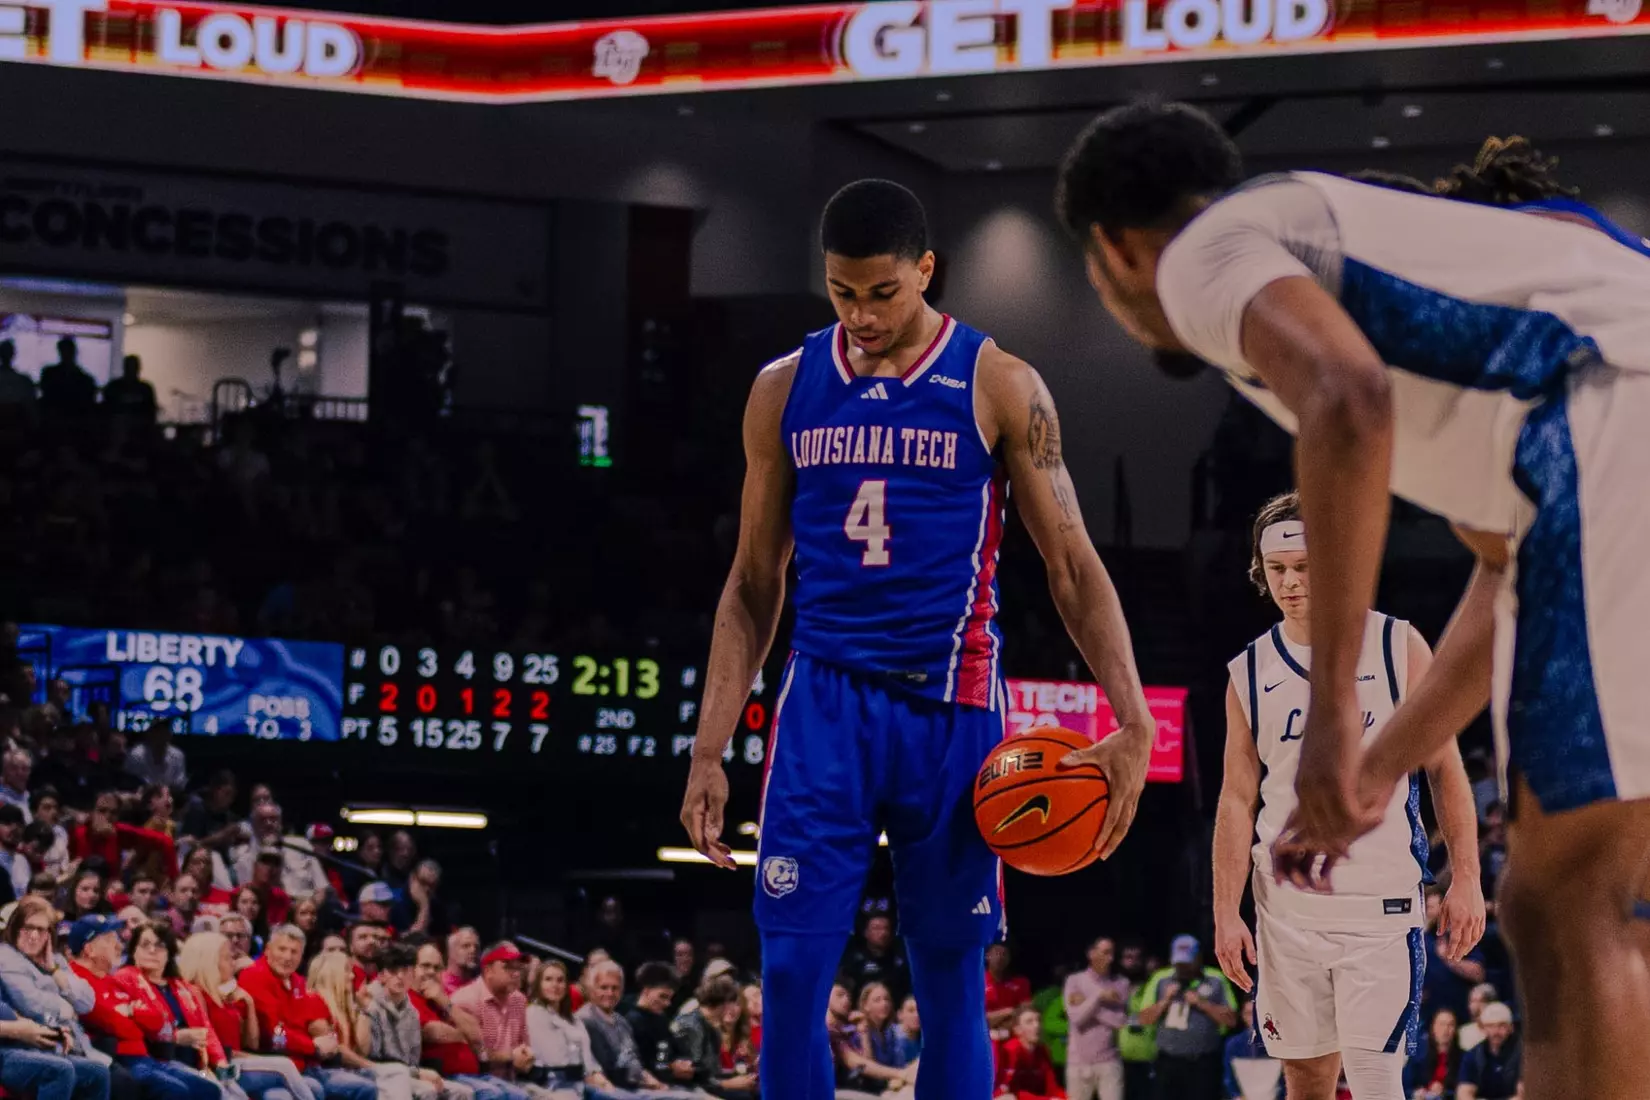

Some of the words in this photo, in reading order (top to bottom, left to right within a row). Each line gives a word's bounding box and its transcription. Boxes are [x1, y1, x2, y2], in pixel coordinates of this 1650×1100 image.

[0, 0, 108, 63] T
[157, 10, 358, 77] LOUD
[845, 0, 1073, 78] GET
[1124, 0, 1330, 48] LOUD
[0, 194, 450, 278] CONCESSIONS
[791, 425, 895, 469] LOUISIANA
[901, 427, 958, 470] TECH
[843, 478, 892, 568] 4
[106, 630, 244, 668] LIBERTY
[379, 646, 400, 676] 0
[417, 648, 438, 678] 3
[455, 651, 476, 680] 4
[493, 652, 515, 682] 9
[523, 653, 560, 684] 25
[143, 666, 204, 713] 68
[572, 655, 660, 699] 2:13
[348, 683, 365, 704] F
[380, 682, 398, 713] 2
[417, 684, 437, 713] 0
[460, 689, 474, 714] 1
[493, 691, 511, 717] 2
[530, 691, 550, 720] 2
[679, 701, 696, 723] F
[746, 703, 766, 730] 0
[1020, 681, 1097, 713] TECH
[341, 717, 371, 738] PT
[378, 717, 398, 746] 5
[411, 719, 443, 748] 15
[446, 720, 482, 749] 25
[493, 722, 512, 751] 7
[530, 724, 549, 753] 7
[596, 708, 636, 729] 2ND
[744, 735, 764, 764] 8
